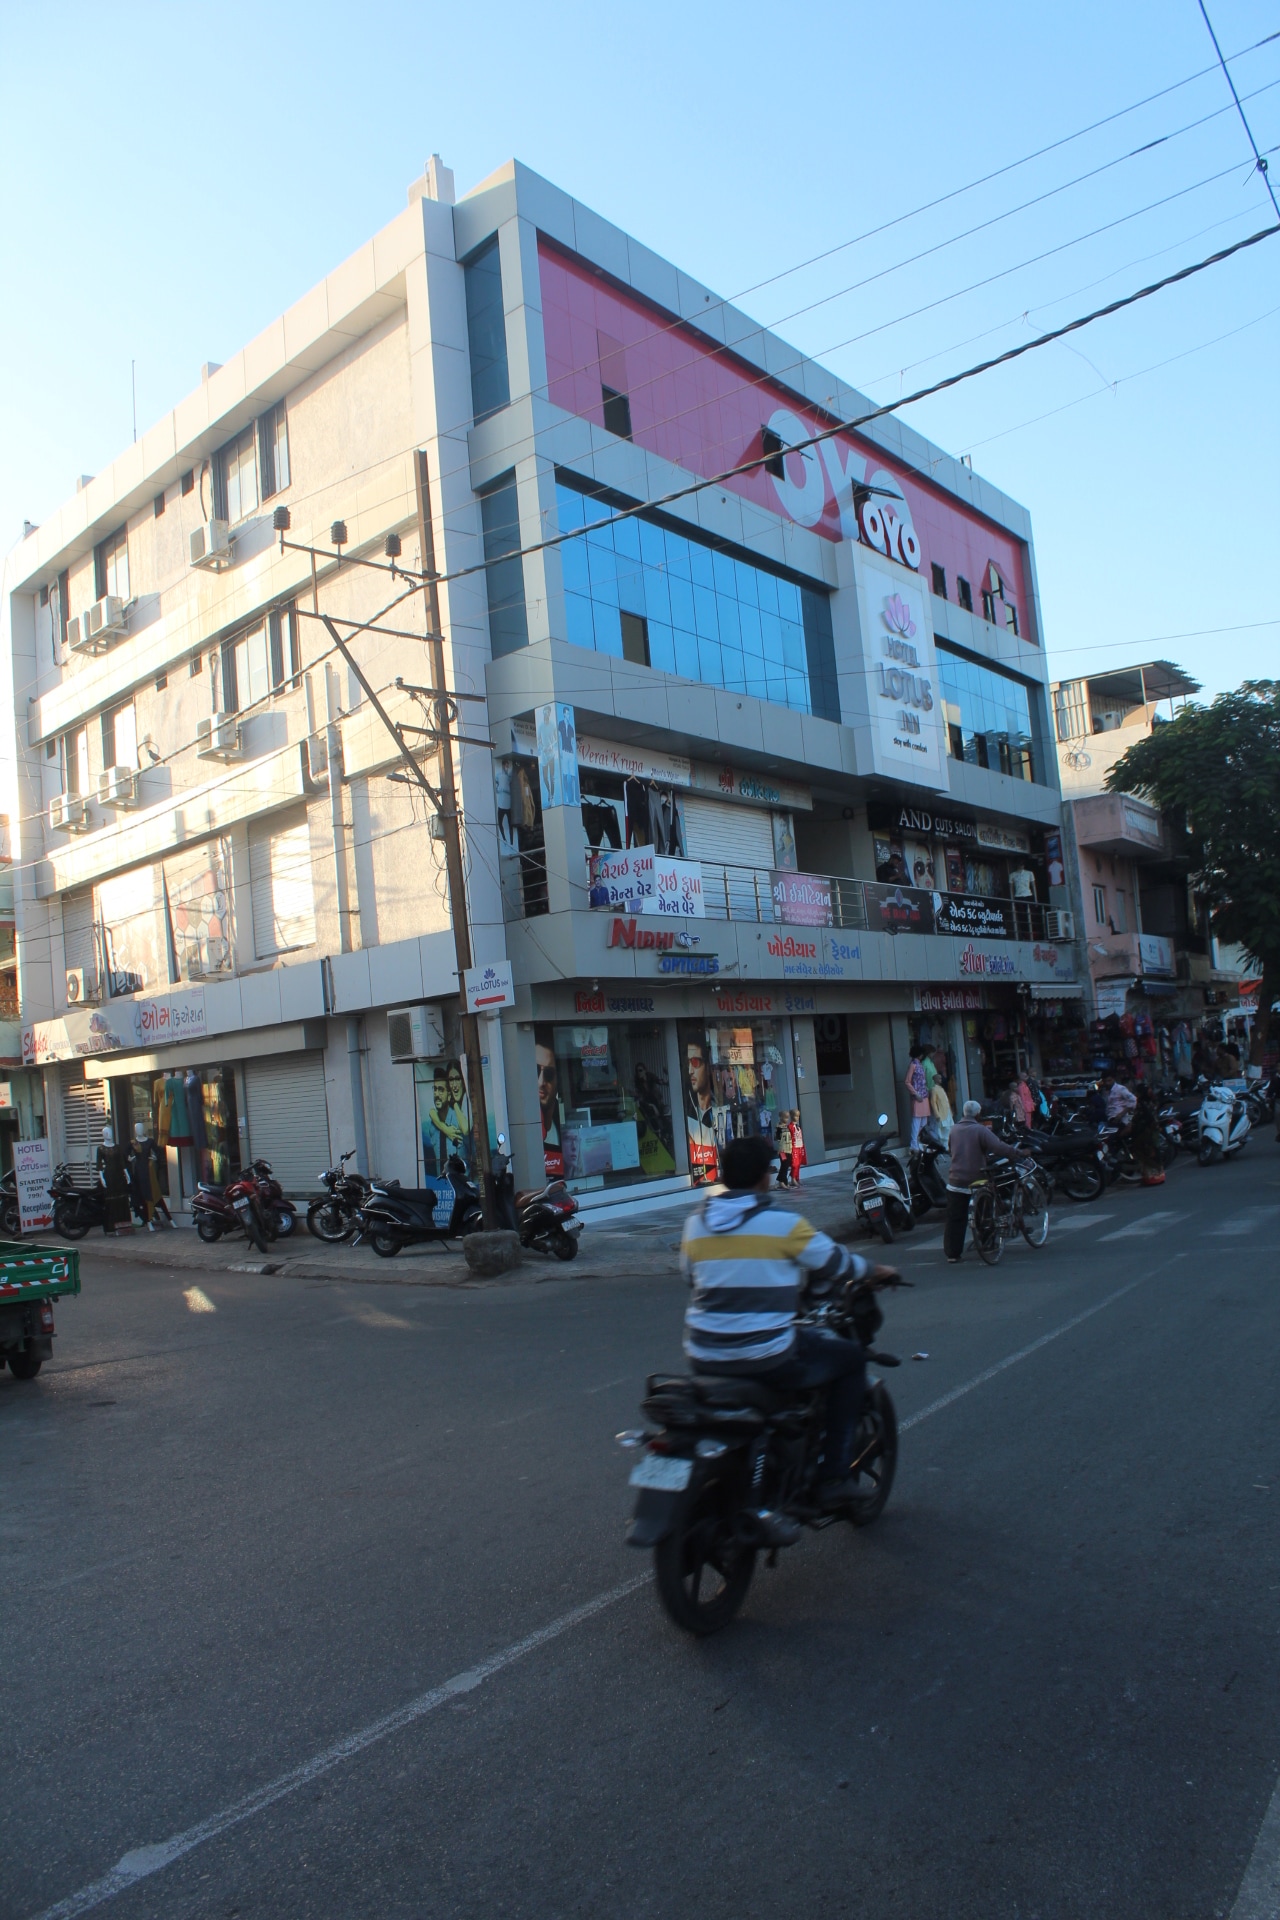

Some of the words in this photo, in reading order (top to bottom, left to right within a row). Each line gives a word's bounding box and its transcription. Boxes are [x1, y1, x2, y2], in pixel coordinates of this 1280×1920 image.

[859, 500, 922, 571] OYO
[878, 662, 934, 712] LOTUS
[579, 743, 609, 765] Verai
[611, 750, 644, 774] Krupa
[899, 807, 932, 832] AND
[934, 817, 953, 834] CUTS
[954, 821, 977, 839] SALON
[602, 857, 629, 879] વેરાઈ
[633, 857, 653, 878] કૃપા
[610, 886, 634, 902] મેન્સ
[637, 880, 652, 896] વેર
[657, 869, 678, 893] રાઈ
[682, 878, 701, 901] કૃપા
[773, 881, 787, 902] શ્રી
[658, 893, 680, 913] મેન્સ
[682, 898, 695, 915] વેર
[610, 917, 676, 949] NIDHI
[766, 935, 817, 959] ખોડીયાર
[831, 938, 861, 960] ફેશન
[661, 957, 720, 974] OPTICALS
[468, 986, 481, 994] HOTEL
[480, 979, 501, 991] LOTUS
[575, 991, 606, 1012] નિધી
[716, 991, 773, 1012] ખોડીયાર
[784, 995, 815, 1012] ફેશન
[142, 1003, 171, 1031] ઓમ
[17, 1144, 45, 1155] HOTEL
[17, 1163, 39, 1172] LOTUS
[19, 1177, 50, 1187] STARTING
[26, 1185, 44, 1193] FROM
[442, 1189, 453, 1200] THE
[22, 1202, 52, 1214] Reception
